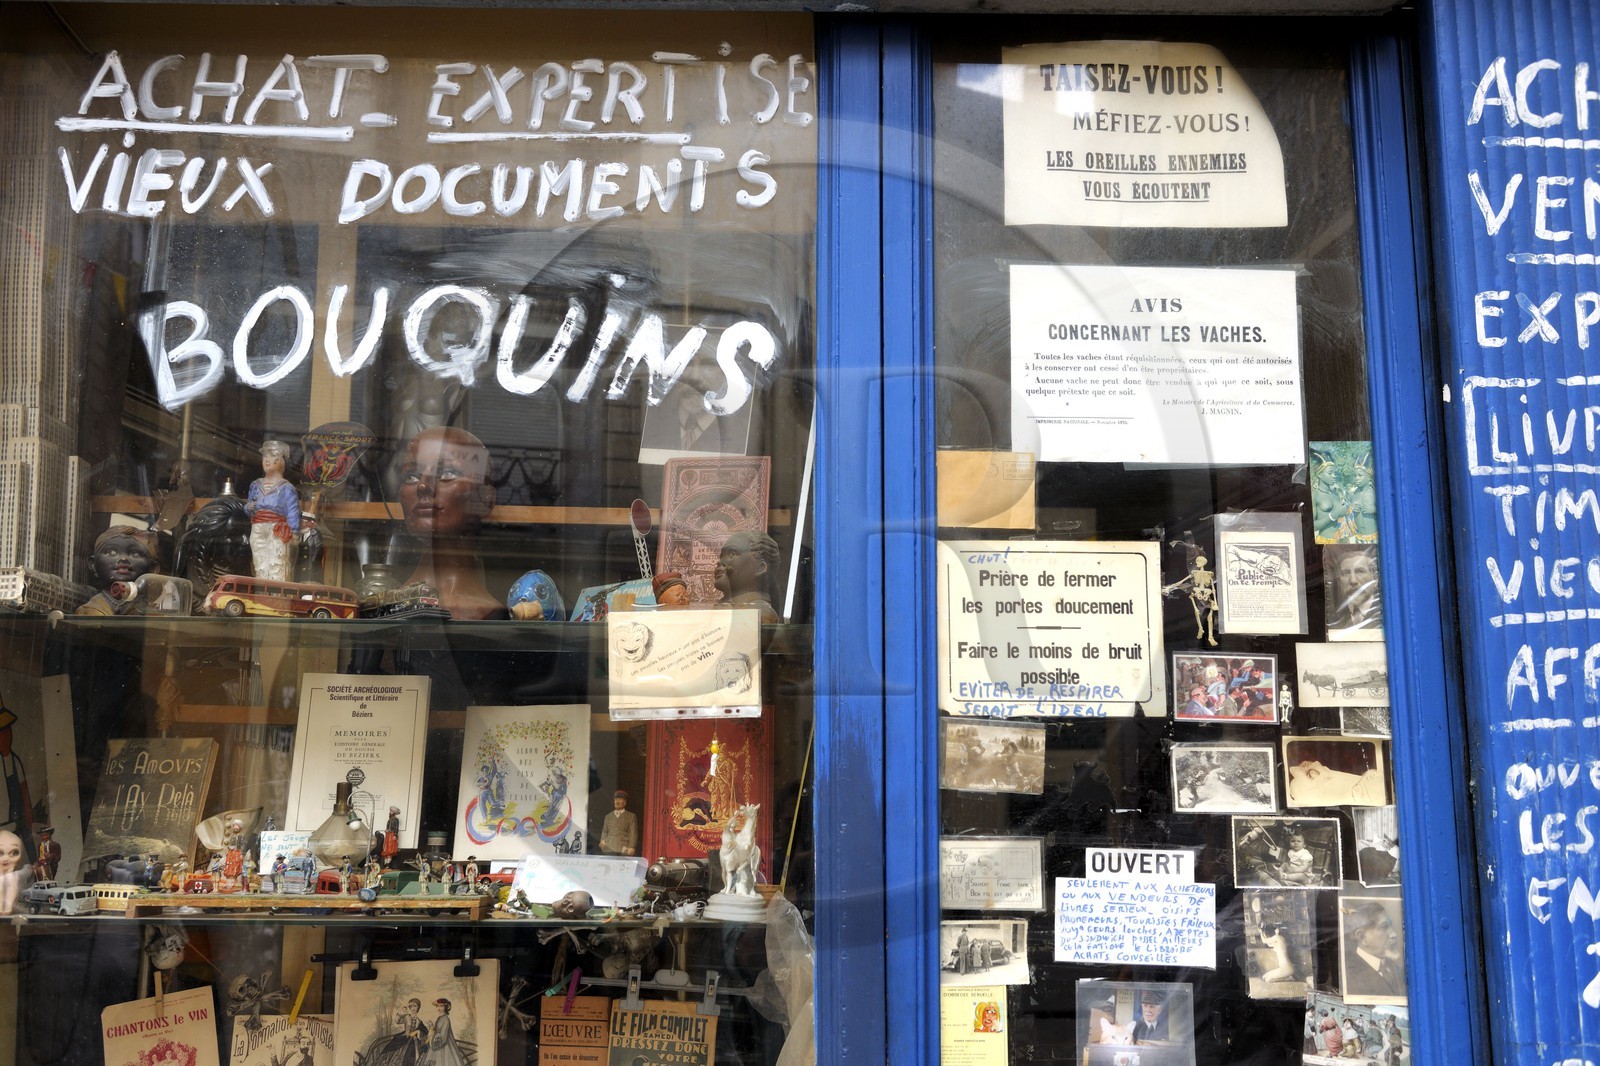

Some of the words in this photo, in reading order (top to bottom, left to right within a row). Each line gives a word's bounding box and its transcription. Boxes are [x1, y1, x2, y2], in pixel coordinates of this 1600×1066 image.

[79, 51, 389, 122] ACHAT
[1047, 151, 1074, 168] LES
[1085, 152, 1156, 171] OREILLES
[1168, 152, 1247, 171] ENNEMIES
[338, 145, 778, 225] DOCUMENTS
[1083, 181, 1121, 199] VOUS
[1132, 178, 1211, 200] ÉCOUTENT
[1130, 298, 1183, 313] AVIS
[1048, 323, 1151, 342] CONCERNANT
[1161, 326, 1190, 342] LES
[1200, 326, 1267, 343] VACHES.
[1076, 353, 1102, 361] vaches
[1104, 353, 1124, 361] étant
[1210, 357, 1223, 366] qui
[1242, 357, 1254, 365] été
[1256, 357, 1293, 365] autorisés
[1032, 363, 1043, 371] les
[1100, 364, 1119, 372] cessé
[1140, 364, 1154, 373] être
[1066, 377, 1088, 385] vache
[1102, 378, 1119, 387] peut
[1123, 377, 1142, 385] donc
[1205, 378, 1218, 387] qui
[1222, 379, 1237, 388] que
[1254, 377, 1272, 386] soit,
[1025, 387, 1056, 396] quelque
[1058, 388, 1090, 397] prétexte
[1092, 389, 1106, 397] que
[1118, 388, 1136, 396] soit.
[979, 569, 1029, 587] Prière
[1037, 570, 1055, 587] de
[1064, 570, 1117, 587] fermer
[1236, 568, 1264, 581] Public
[962, 598, 983, 613] les
[995, 598, 1043, 617] portes
[1055, 598, 1134, 614] doucement
[697, 651, 714, 661] vin.
[957, 642, 998, 659] Faire
[1007, 642, 1020, 659] le
[1029, 642, 1072, 659] moins
[1082, 643, 1099, 659] de
[1108, 643, 1142, 660] bruit
[1020, 668, 1081, 687] possible
[327, 685, 353, 693] SOCIÉTÉ
[353, 686, 403, 694] ARCHÉOLOGIQUE
[1015, 686, 1035, 700] DE
[329, 694, 364, 703] Scientifique
[373, 694, 399, 702] Littéraire
[352, 710, 373, 718] Béziers
[105, 759, 126, 775] les
[1520, 804, 1598, 855] LES
[1091, 851, 1185, 875] OUVERT
[1189, 896, 1205, 906] DE
[107, 1017, 169, 1039] CHANTONS
[174, 1014, 185, 1025] le
[188, 1008, 208, 1022] VIN
[612, 1011, 628, 1036] LE
[630, 1013, 658, 1037] FILM
[660, 1014, 708, 1042] COMPLET
[643, 1032, 674, 1040] SAMEDI
[612, 1038, 669, 1051] DRESSEZ
[675, 1042, 709, 1054] DONC
[657, 1053, 698, 1064] VOTRE
